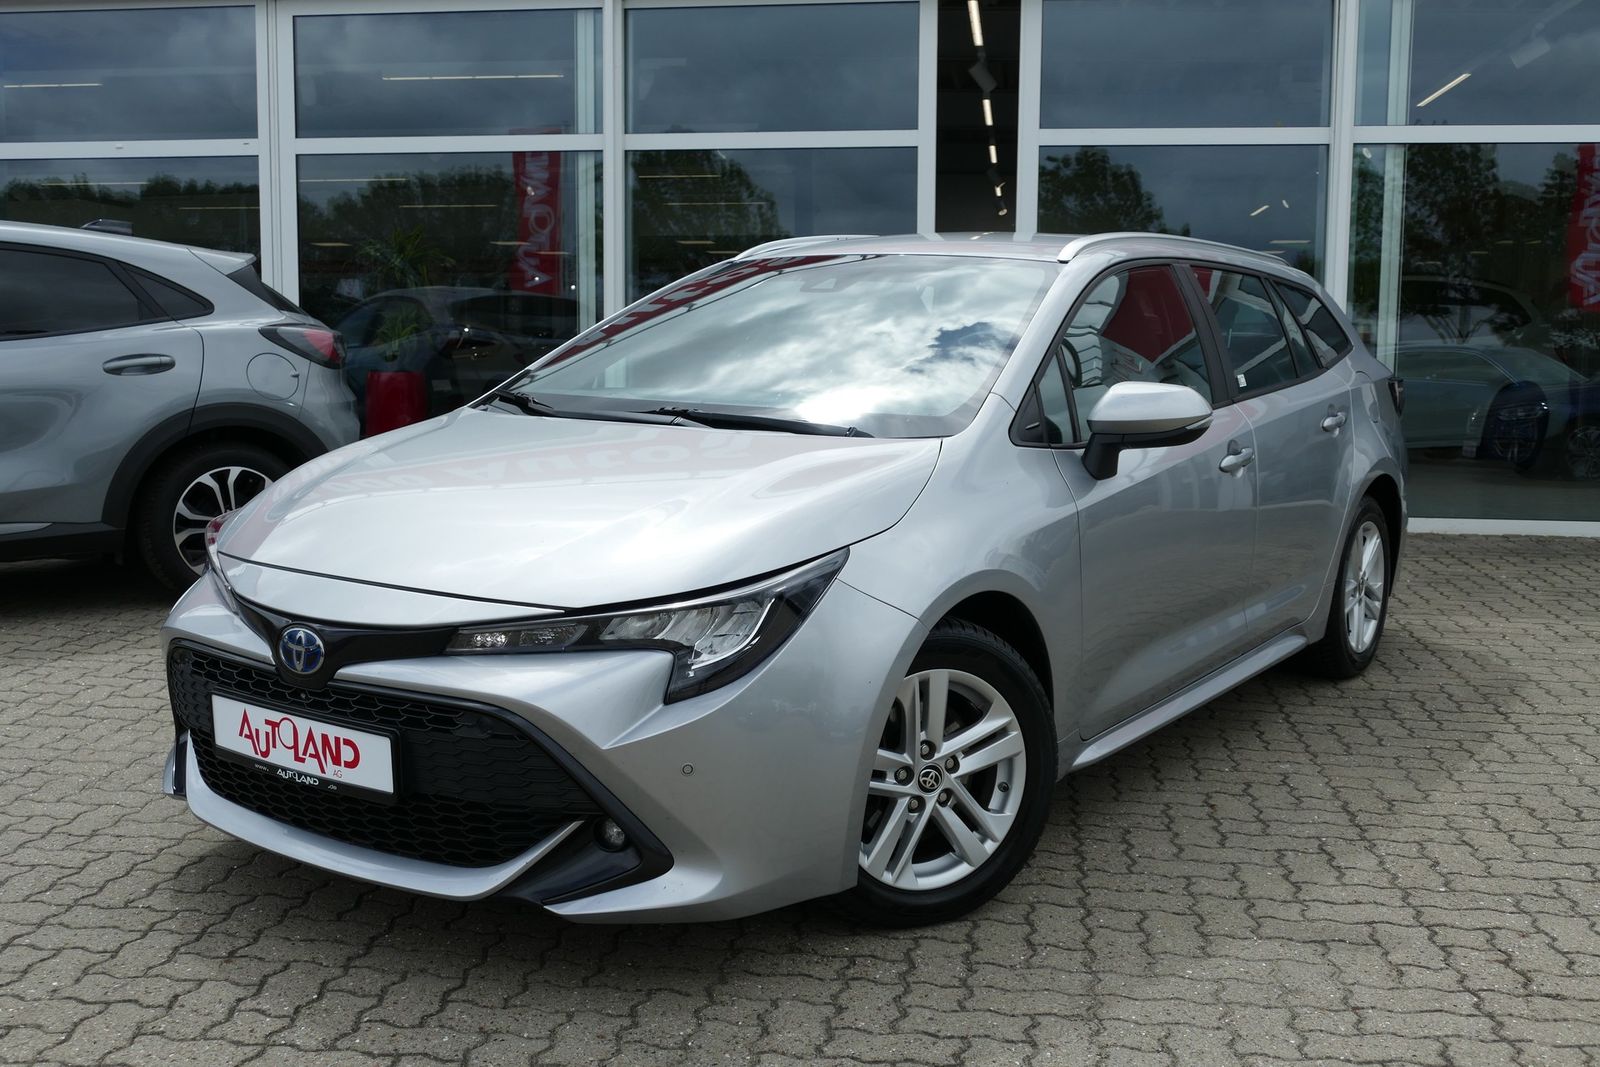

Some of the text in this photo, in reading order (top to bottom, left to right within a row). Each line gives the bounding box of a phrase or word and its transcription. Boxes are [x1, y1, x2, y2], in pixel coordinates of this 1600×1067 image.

[238, 707, 361, 775] AUTOLAND
[276, 768, 319, 786] AUTOLAND
[332, 768, 343, 779] AG
